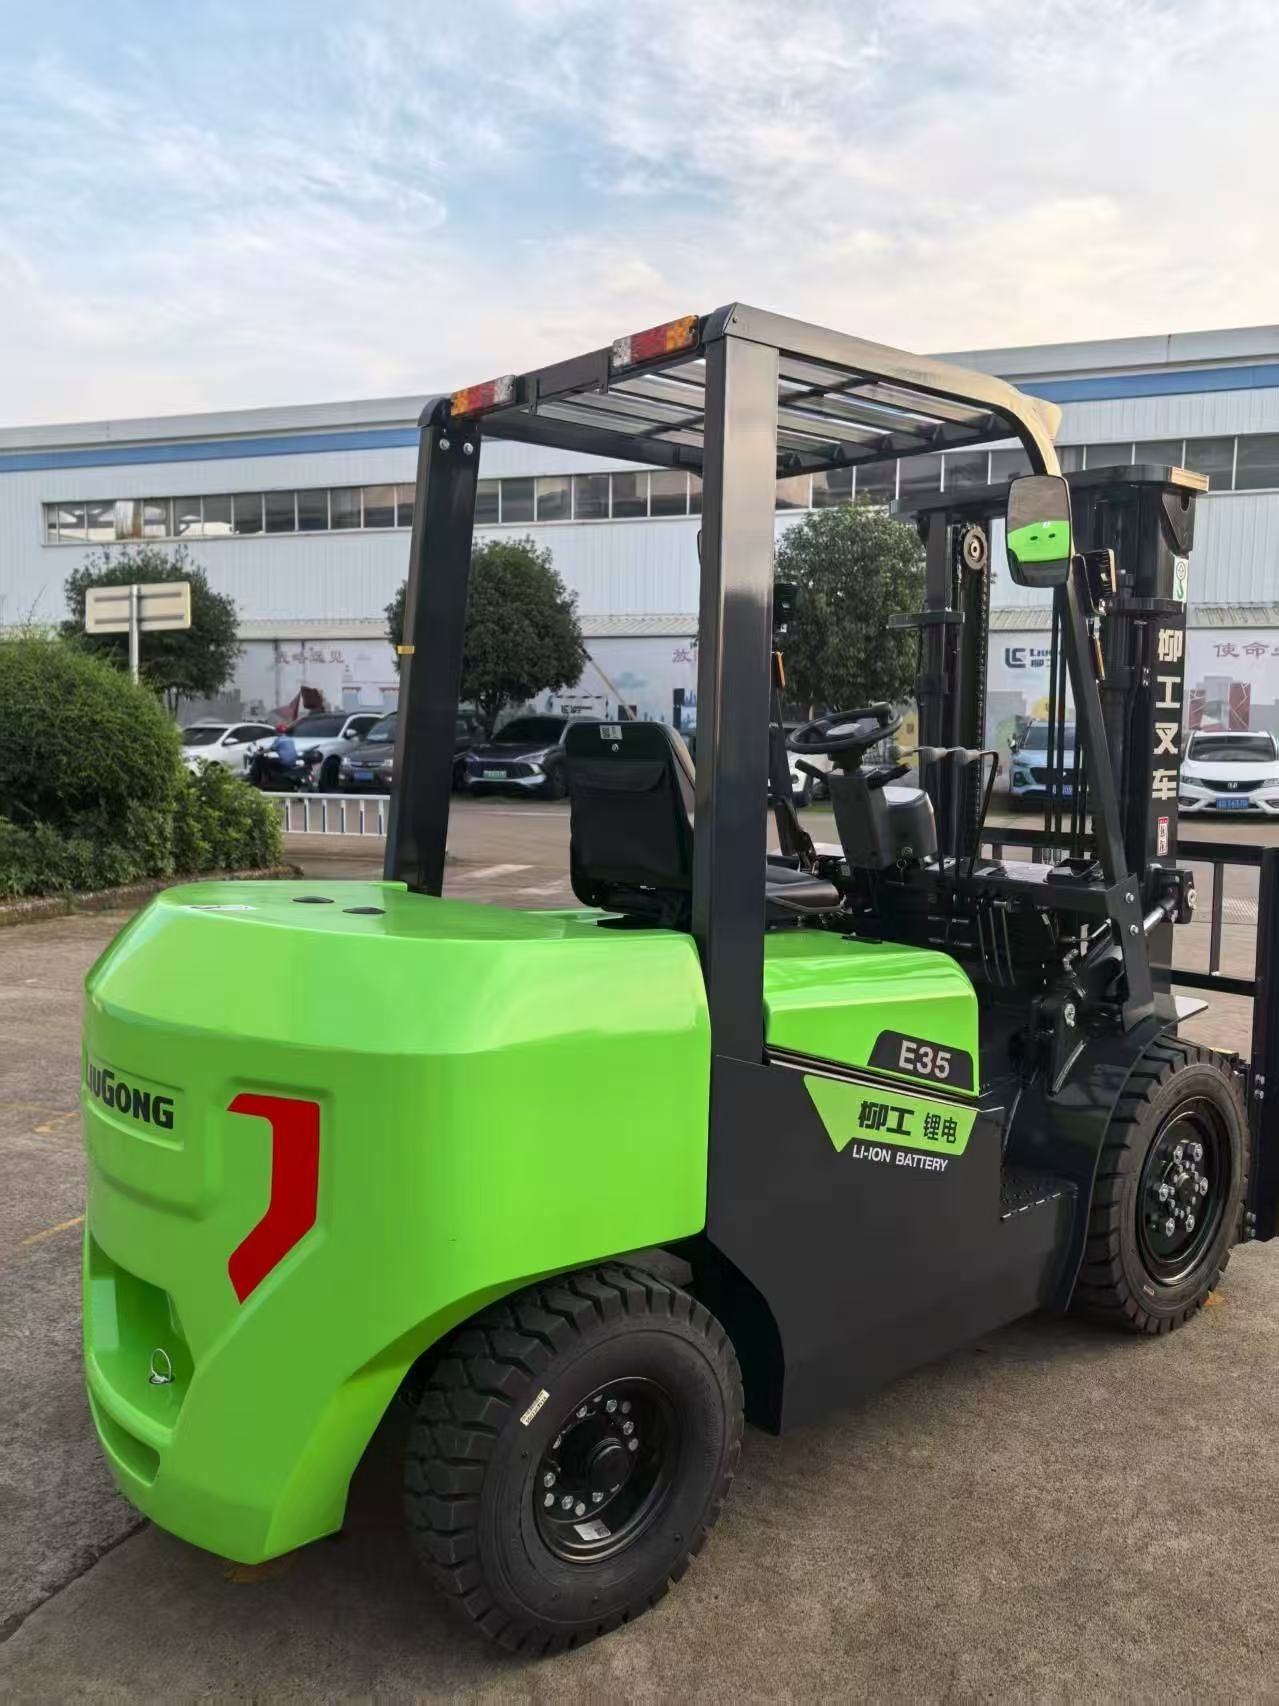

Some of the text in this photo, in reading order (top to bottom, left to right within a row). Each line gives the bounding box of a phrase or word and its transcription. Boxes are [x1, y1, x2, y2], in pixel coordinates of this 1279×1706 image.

[1152, 628, 1183, 800] 柳工叉车
[899, 1039, 952, 1079] E35
[857, 1100, 957, 1143] 柳工 锂电
[852, 1144, 948, 1172] LI-ION BATTERY
